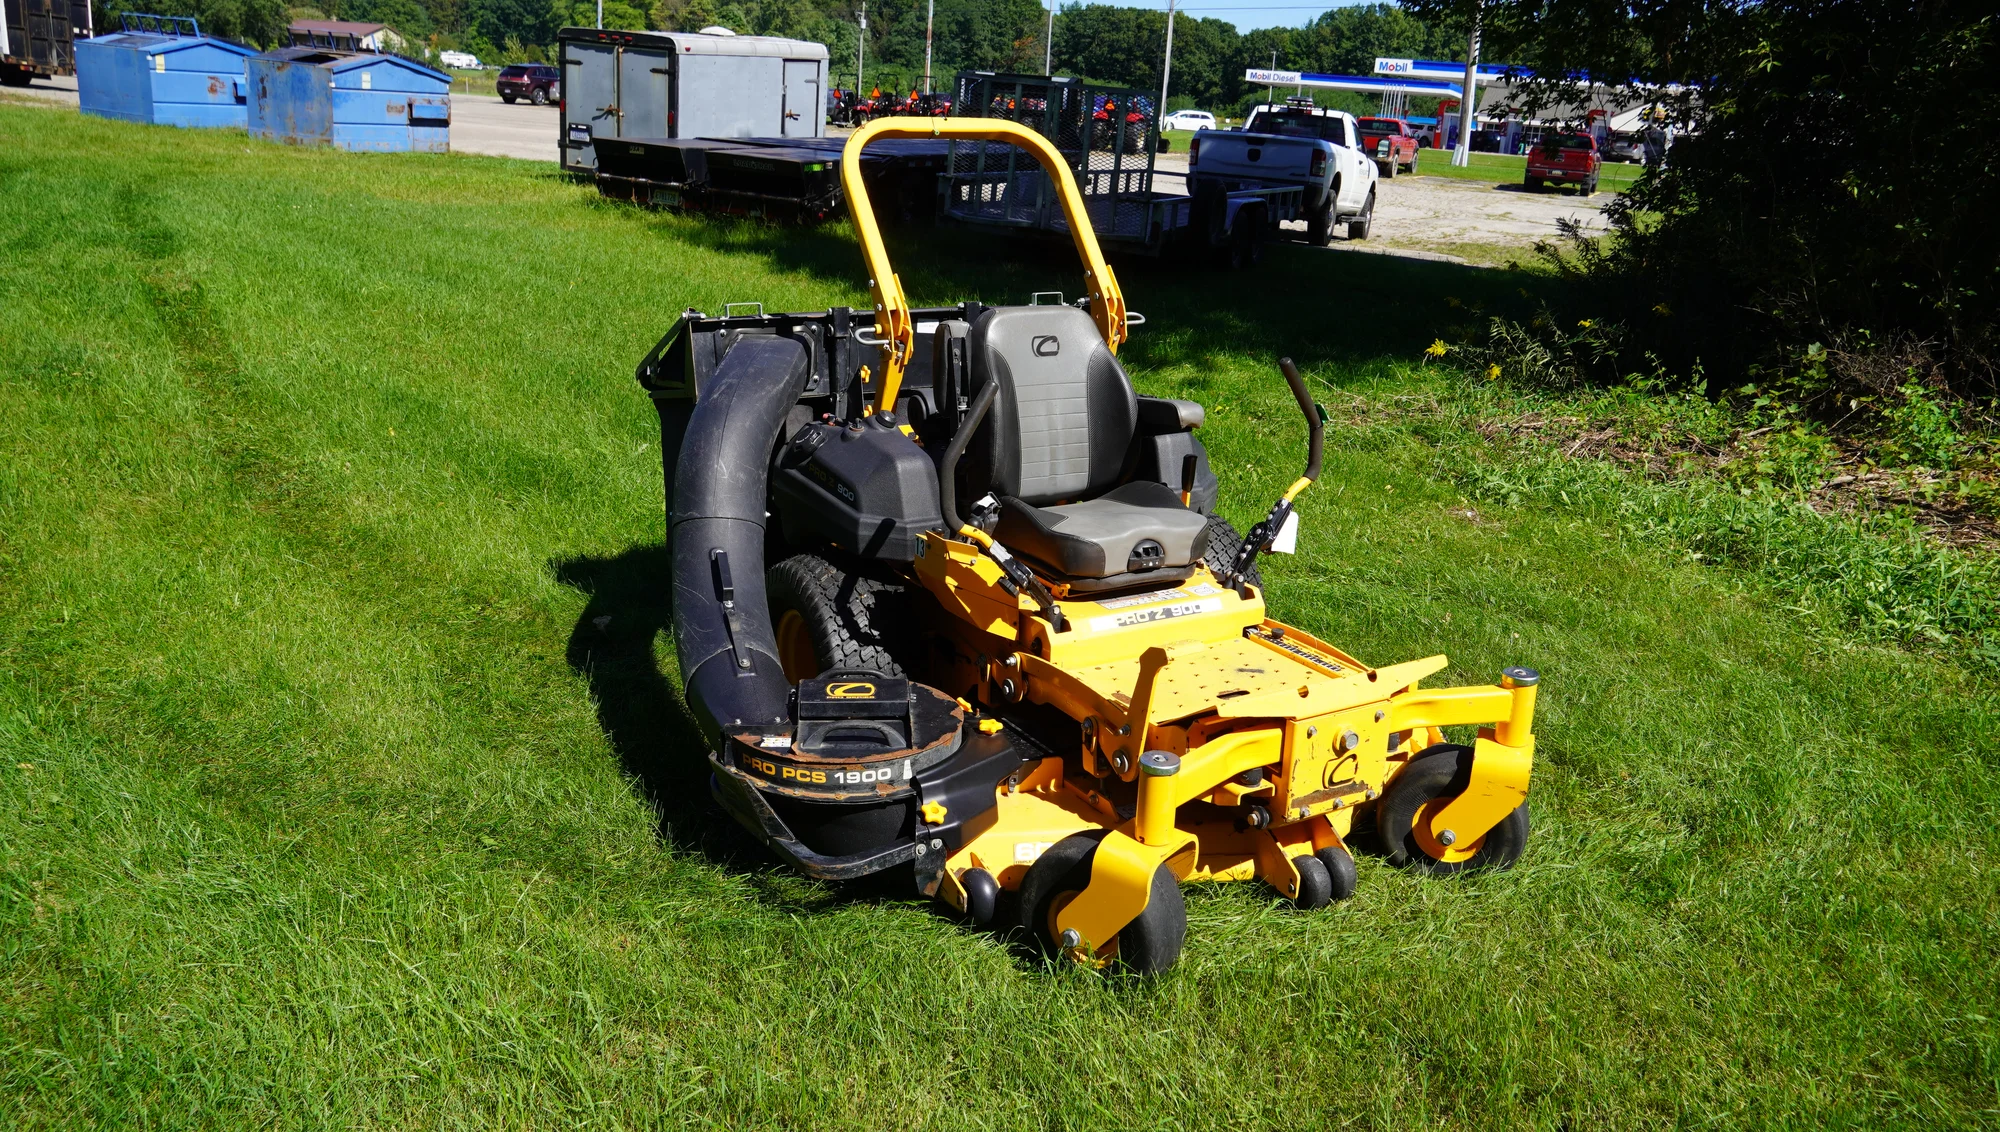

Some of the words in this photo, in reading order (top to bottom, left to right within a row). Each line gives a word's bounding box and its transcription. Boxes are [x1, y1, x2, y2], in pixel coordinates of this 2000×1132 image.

[1379, 61, 1407, 72] Mobil
[1250, 72, 1271, 80] Mobil
[1272, 73, 1296, 82] Diesel
[807, 463, 827, 482] PRO
[837, 483, 855, 502] 900
[1115, 612, 1150, 626] PRO
[1154, 609, 1167, 620] Z
[742, 753, 776, 775] PRO
[782, 766, 827, 784] PCS
[833, 767, 892, 784] 1900
